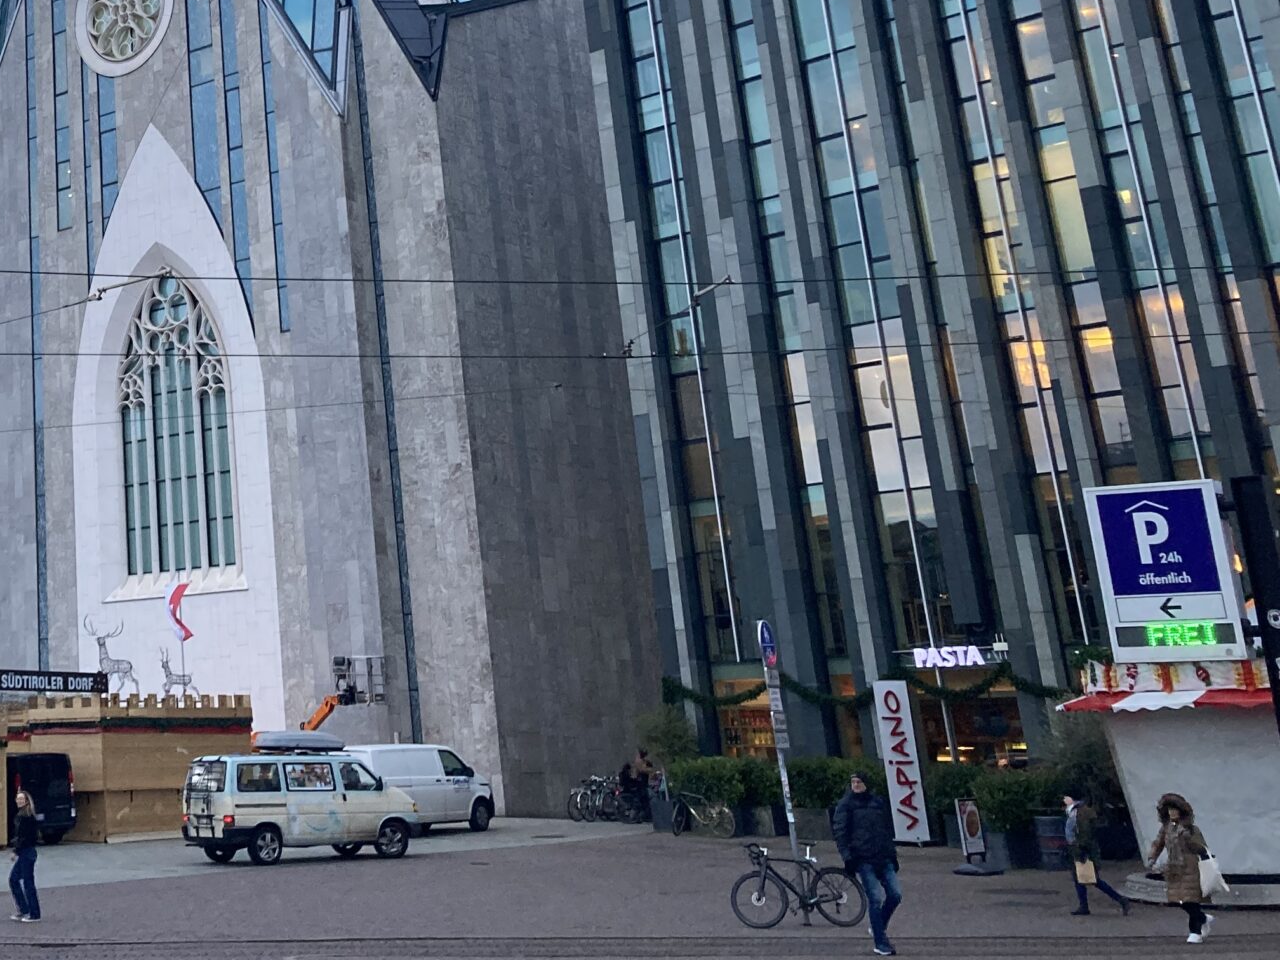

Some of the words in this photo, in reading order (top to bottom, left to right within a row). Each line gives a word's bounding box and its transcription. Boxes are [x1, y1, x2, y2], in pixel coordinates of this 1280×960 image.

[1132, 511, 1170, 565] P
[1159, 552, 1183, 564] 24h
[1139, 571, 1192, 586] öffentlich
[1146, 622, 1217, 647] FREI
[913, 645, 986, 668] PASTA
[1, 672, 63, 689] SÜDTIROLER
[68, 677, 94, 691] DORF
